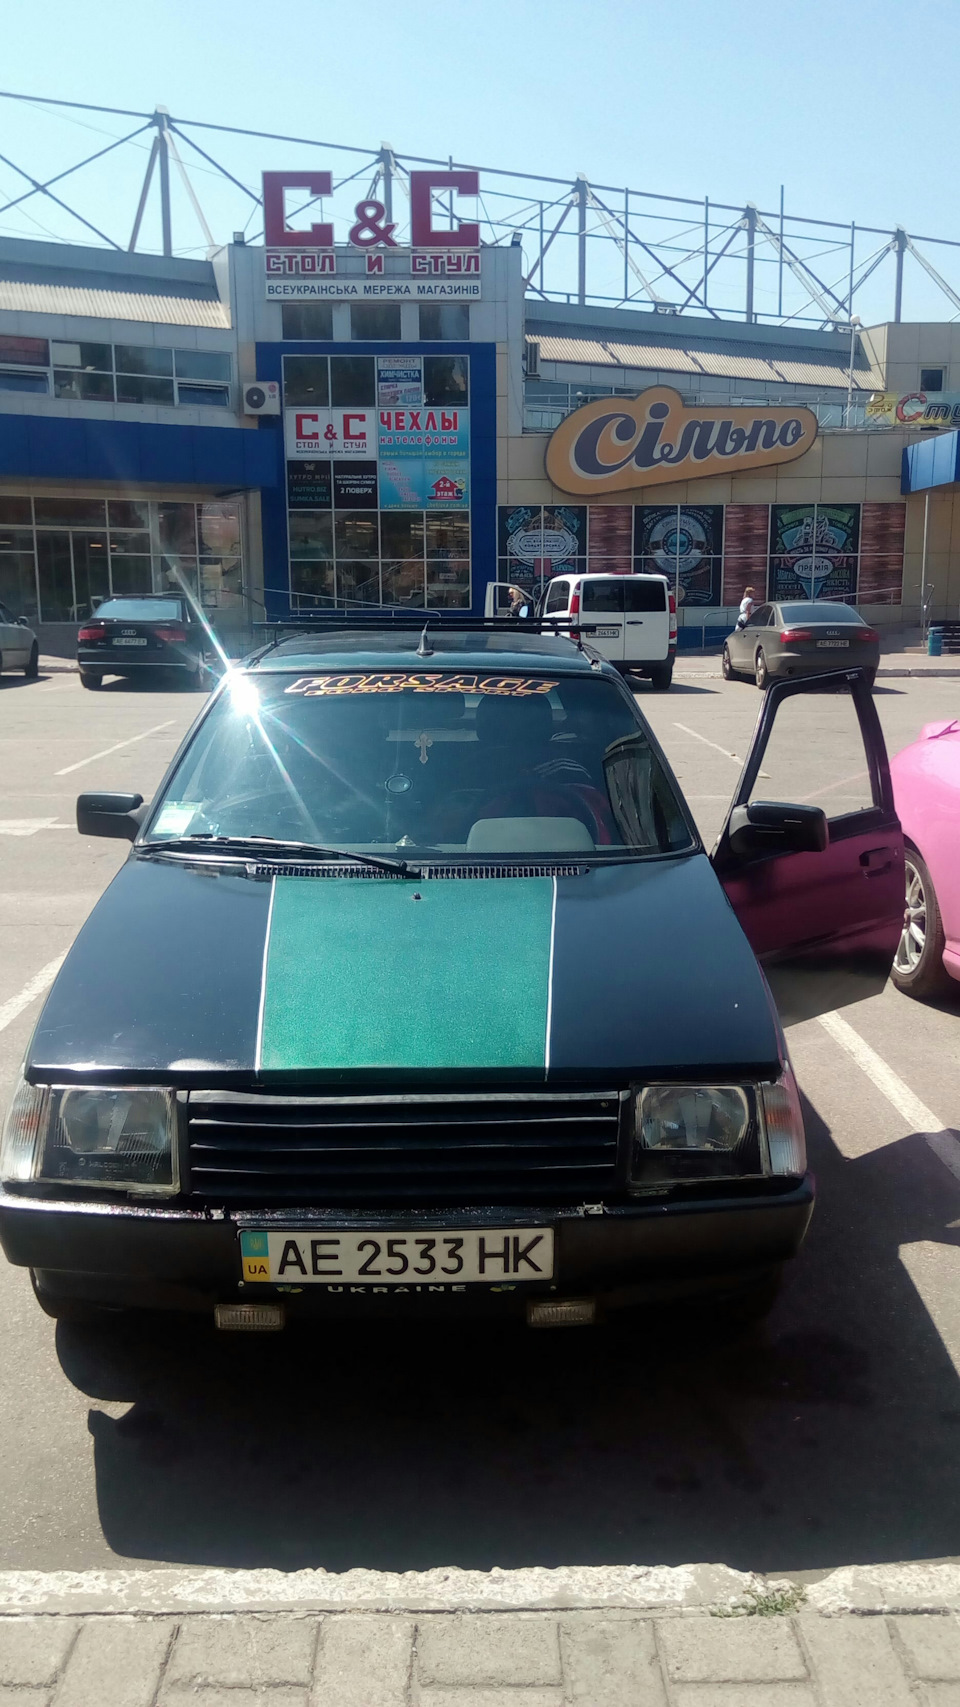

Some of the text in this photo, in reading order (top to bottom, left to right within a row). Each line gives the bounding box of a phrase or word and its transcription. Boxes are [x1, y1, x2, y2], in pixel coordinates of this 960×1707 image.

[265, 253, 481, 274] СТОЛ И СТУЛ
[363, 285, 411, 295] МЕРЕЖА
[417, 285, 480, 295] МАГАЗИНІВ
[379, 411, 458, 431] ЧЕХЛЫ
[379, 434, 458, 447] на телефоны
[573, 401, 806, 475] Сільпо
[296, 441, 320, 449] СТОЛ
[343, 441, 367, 449] СТУЛ
[797, 564, 829, 572] ПРЕМІЯ
[284, 674, 561, 694] FORSAGE
[278, 1235, 544, 1276] AE 2533 HK
[248, 1264, 268, 1275] UA
[327, 1284, 467, 1294] UKRAINE
